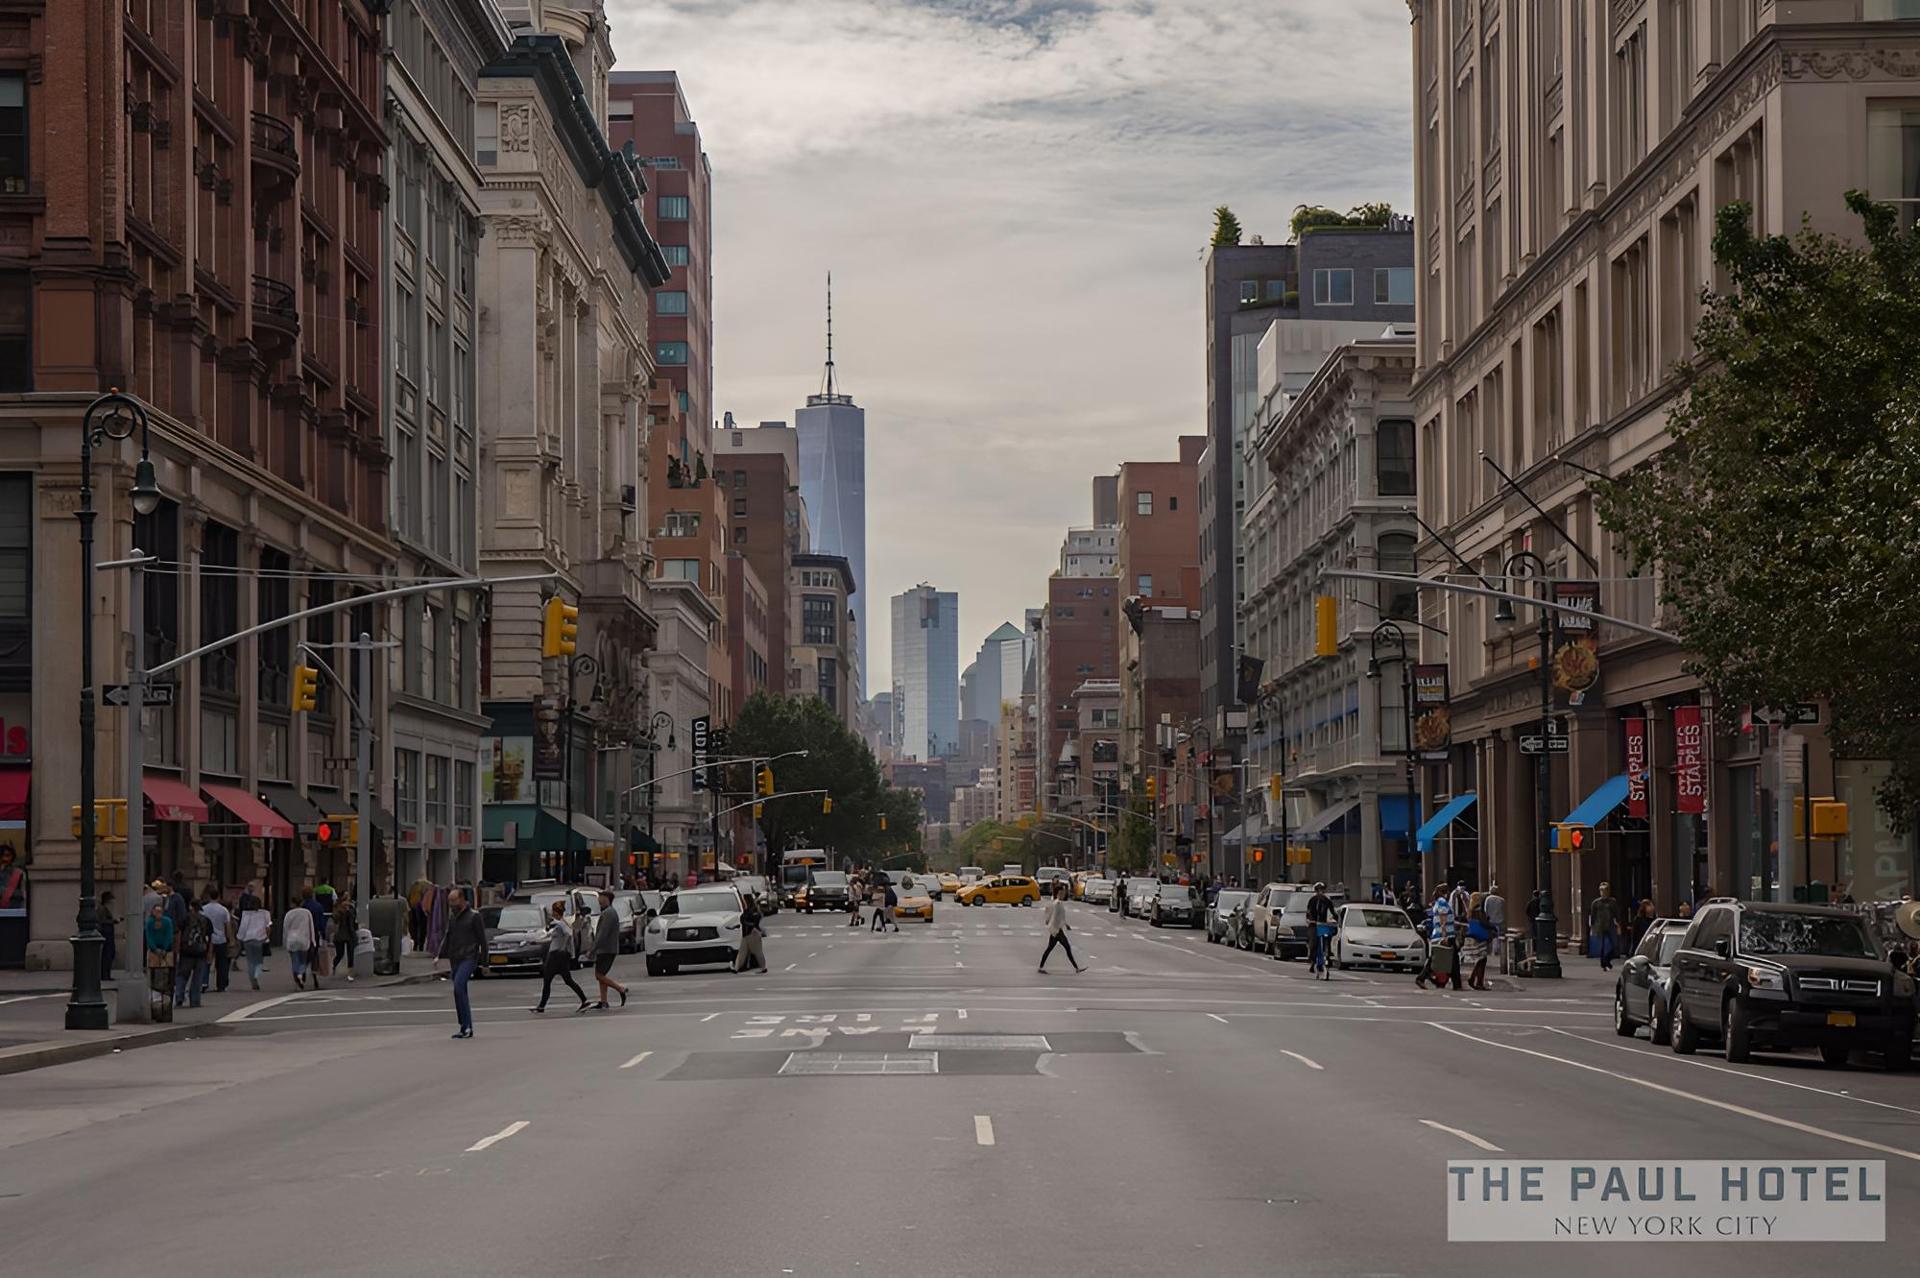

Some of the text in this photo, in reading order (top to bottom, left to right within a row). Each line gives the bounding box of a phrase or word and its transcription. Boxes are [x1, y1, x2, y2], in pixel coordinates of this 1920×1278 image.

[694, 720, 707, 747] OLD
[1685, 724, 1702, 796] STAPLES
[1629, 735, 1645, 801] STAPLES
